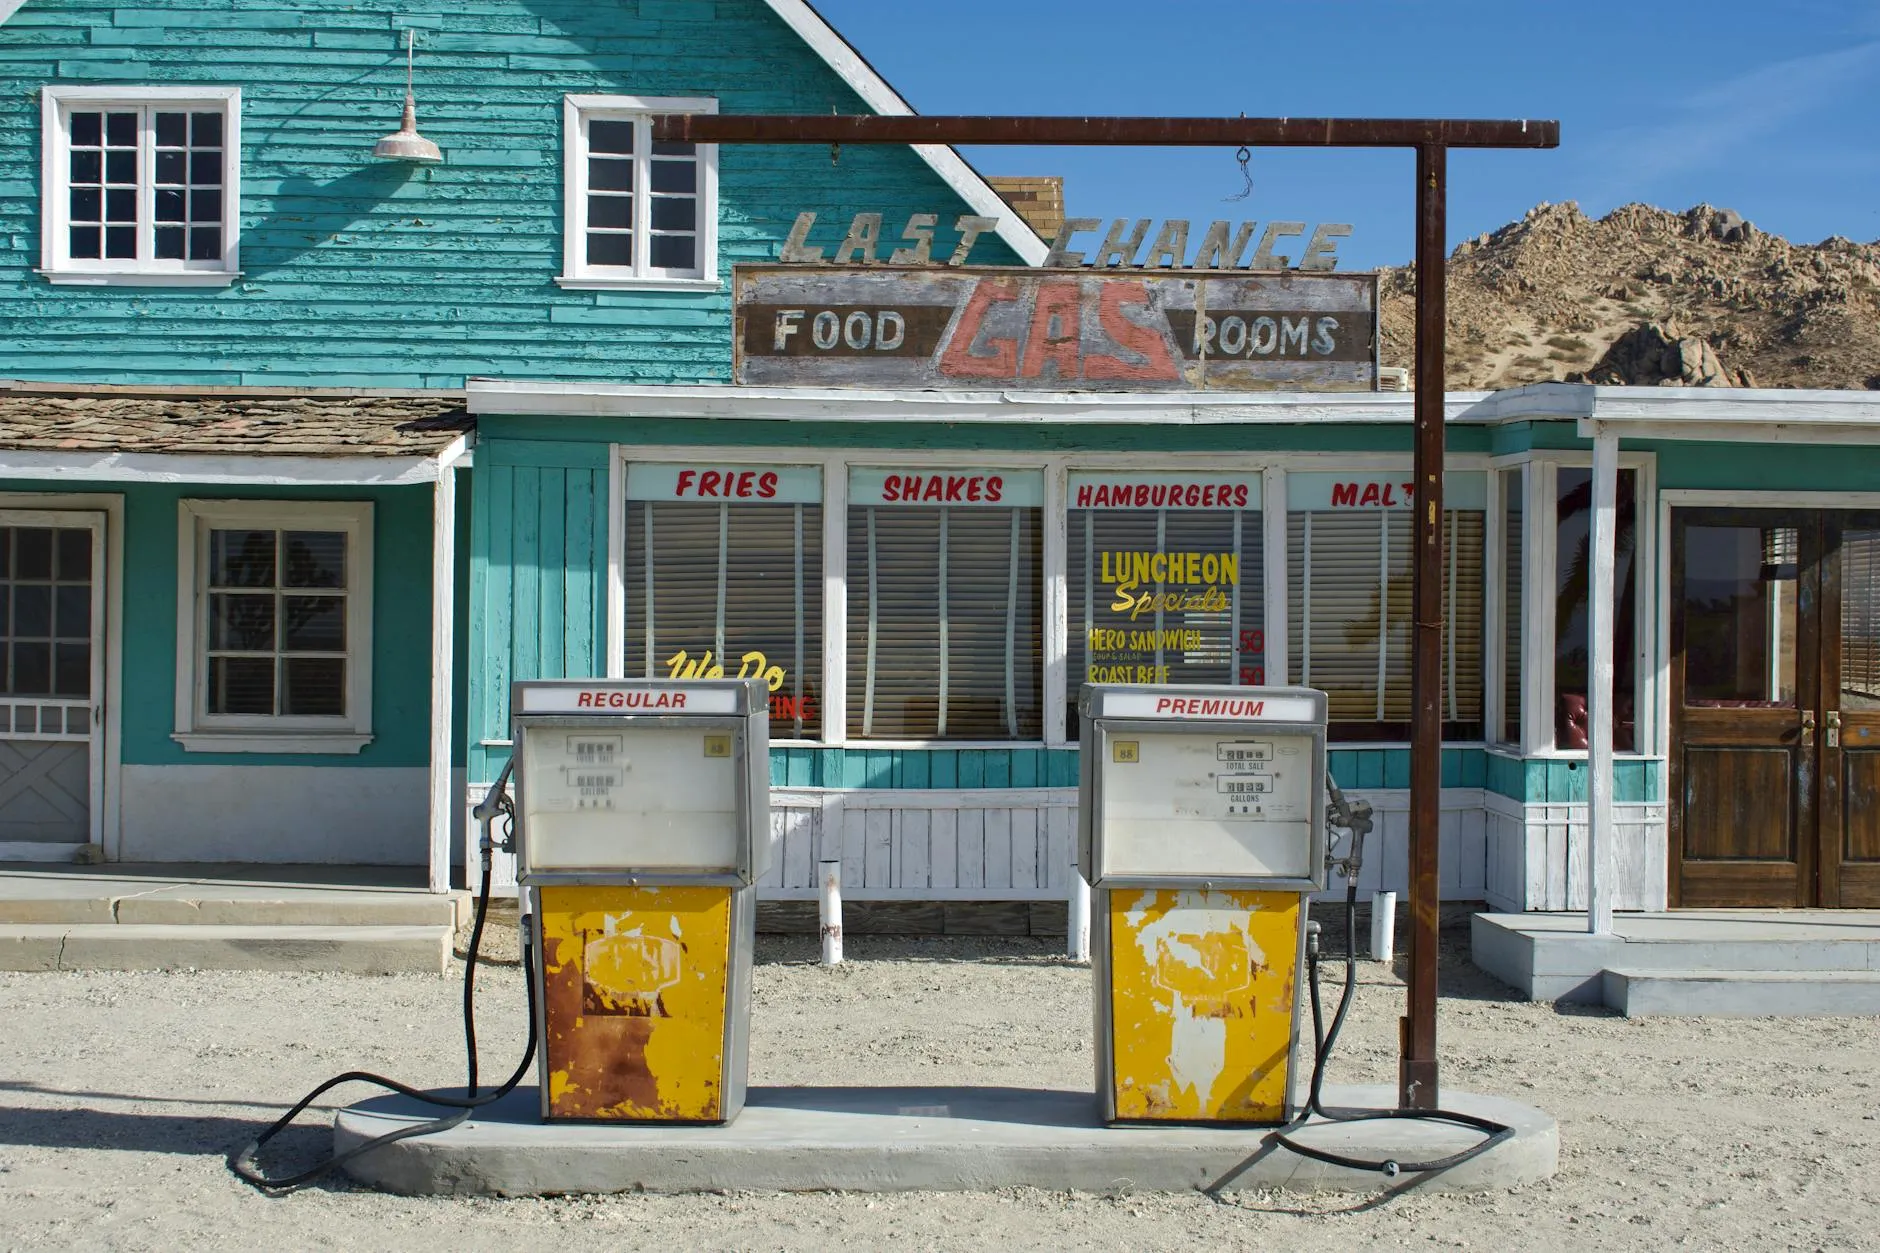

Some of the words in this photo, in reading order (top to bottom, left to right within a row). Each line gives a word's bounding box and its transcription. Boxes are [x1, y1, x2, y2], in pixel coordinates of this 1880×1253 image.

[779, 211, 999, 265] LAST
[1043, 217, 1353, 271] CHANCE
[774, 309, 905, 351] FOOD
[940, 280, 1180, 380] GAS
[1193, 315, 1340, 356] ROOMS
[676, 470, 778, 498] FRIES
[882, 475, 1003, 502] SHAKES
[1077, 484, 1249, 507] HAMBURGERS
[1102, 551, 1239, 585] LUNCHEON
[1111, 582, 1228, 621] Specials
[1089, 628, 1125, 651] HERO
[1129, 628, 1201, 652] SANDWICH
[666, 650, 724, 679] We
[736, 651, 787, 691] Do
[1088, 664, 1133, 684] ROAST
[1136, 665, 1171, 684] BEEF
[577, 692, 687, 708] REGULAR
[1156, 698, 1264, 716] PREMIUM
[1226, 762, 1245, 770] TOTAL
[1248, 762, 1264, 770] SALE
[1230, 794, 1260, 802] GALLONS
